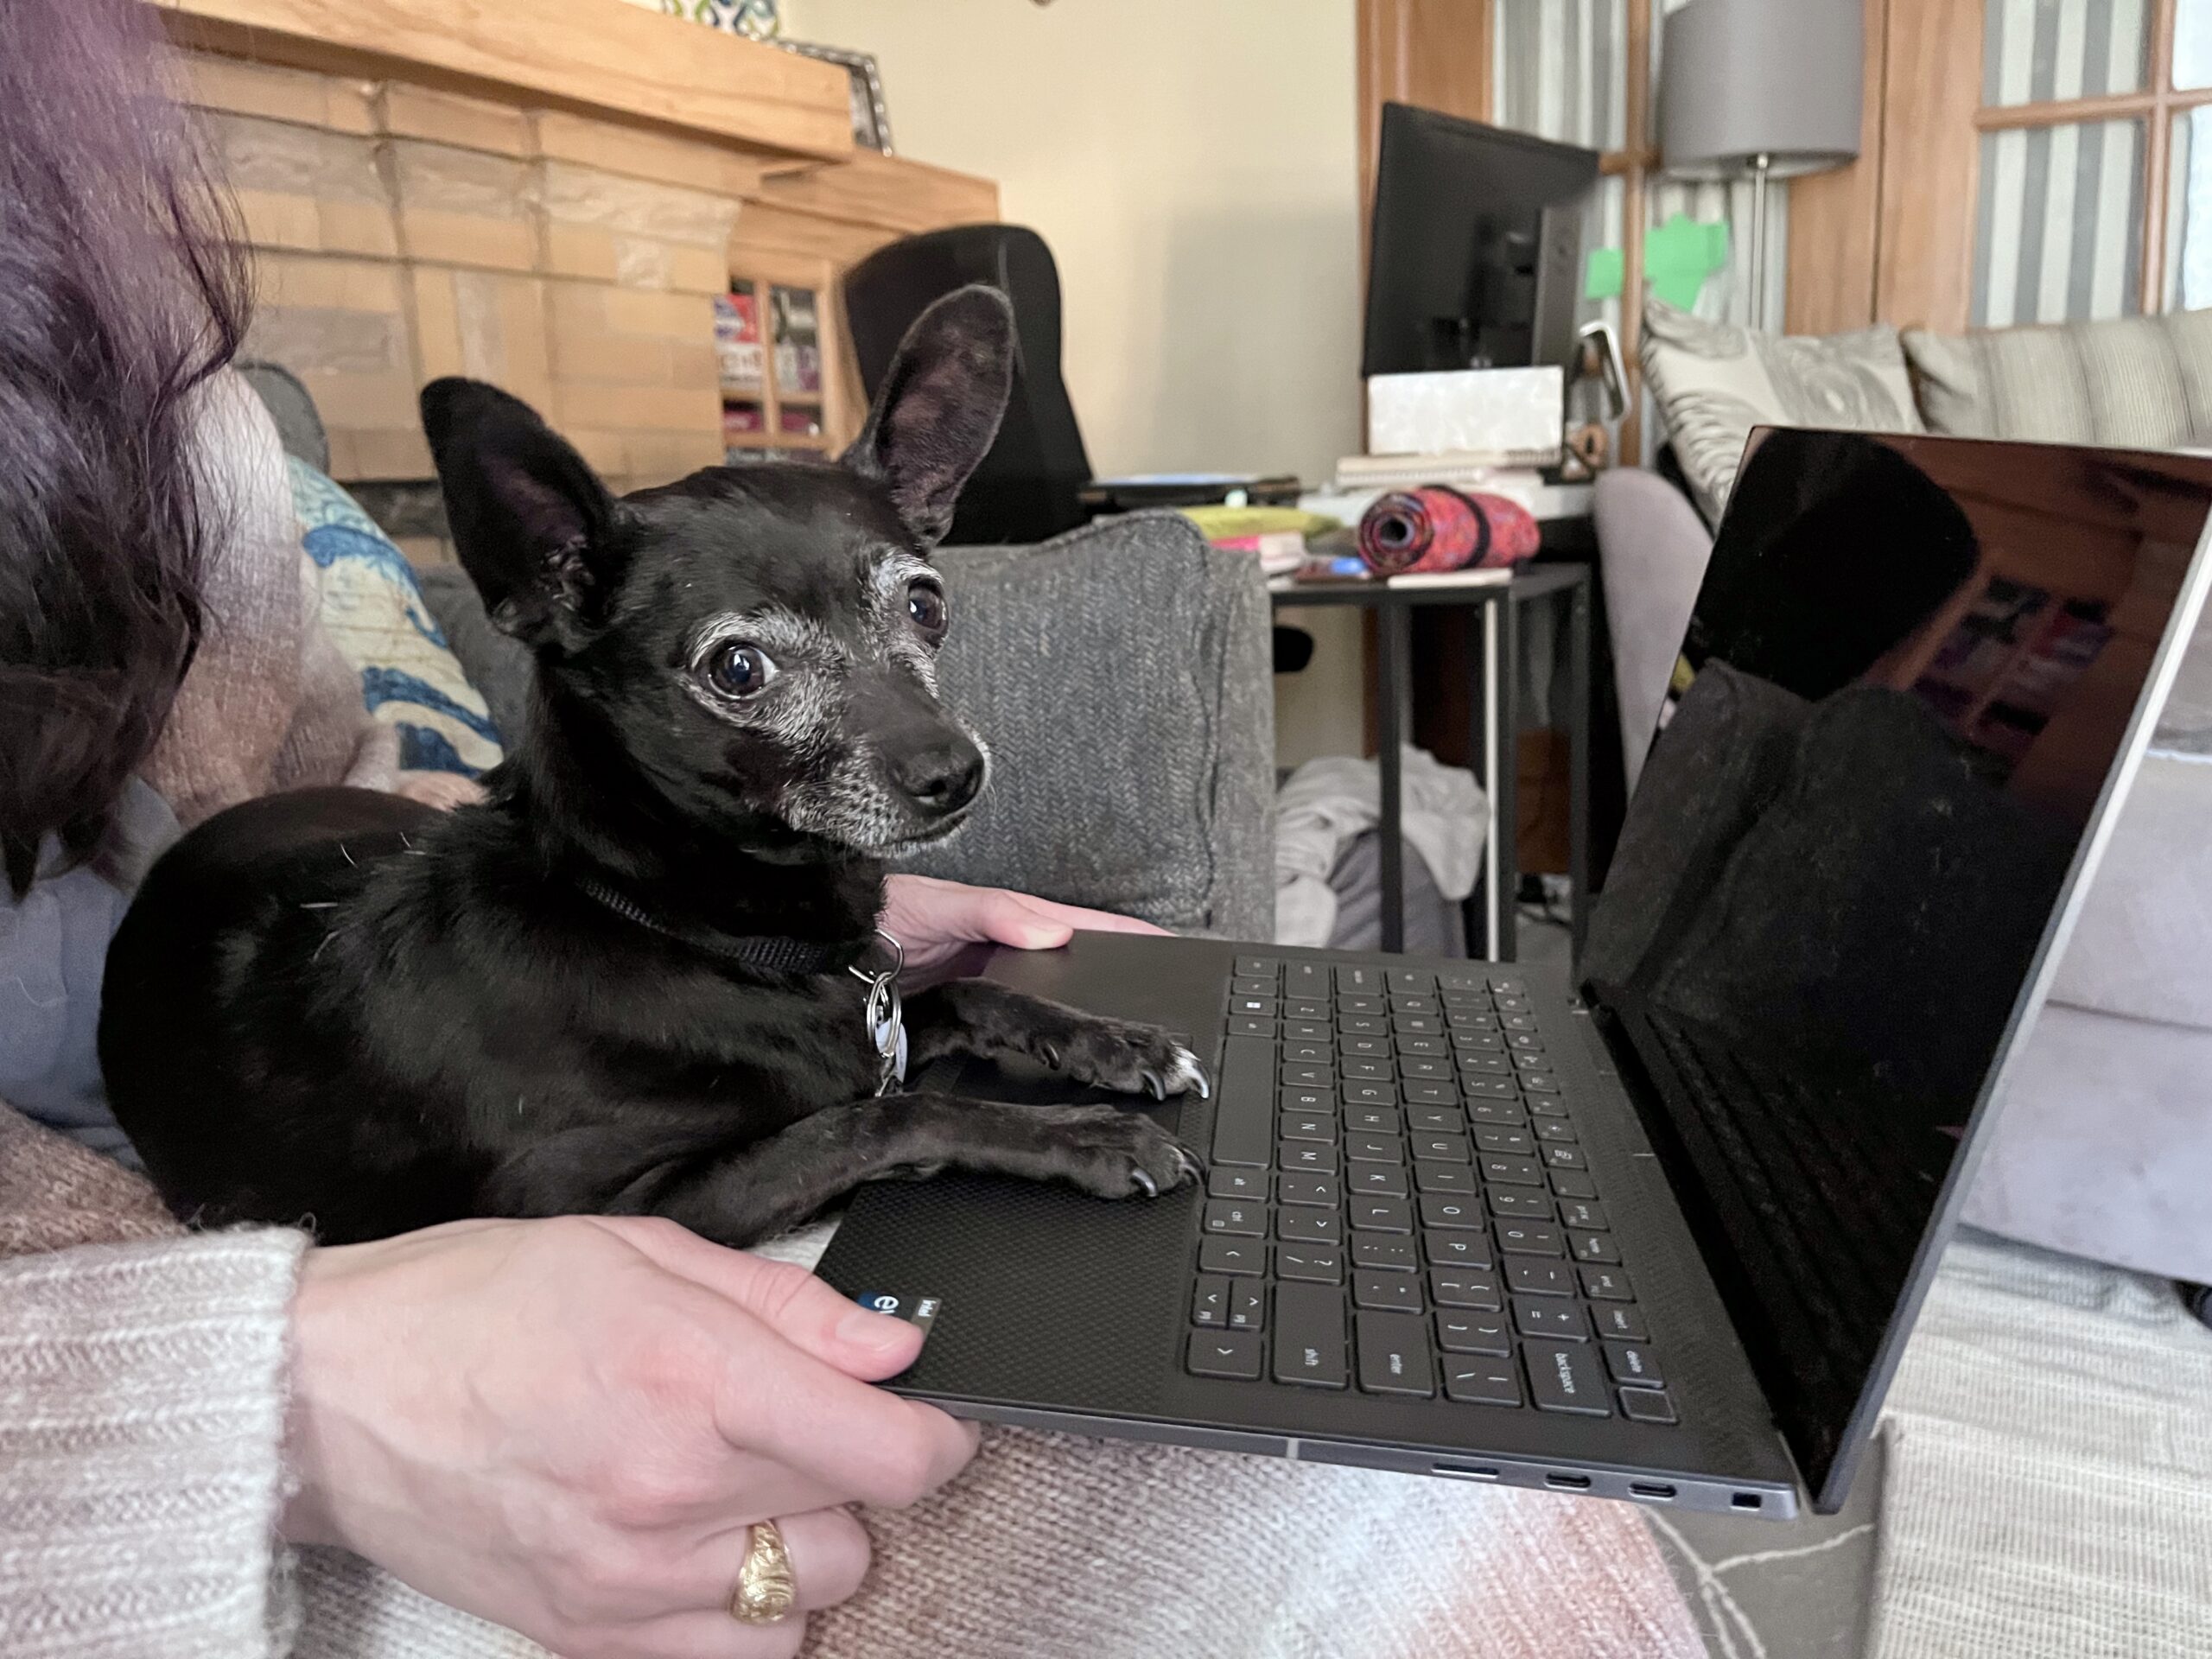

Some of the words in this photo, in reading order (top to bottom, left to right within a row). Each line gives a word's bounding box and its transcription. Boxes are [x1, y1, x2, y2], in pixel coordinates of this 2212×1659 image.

[918, 1299, 937, 1318] intel
[1304, 1348, 1319, 1366] shift
[1389, 1353, 1402, 1375] enter
[1625, 1350, 1642, 1373] delete
[1554, 1352, 1575, 1394] backspace
